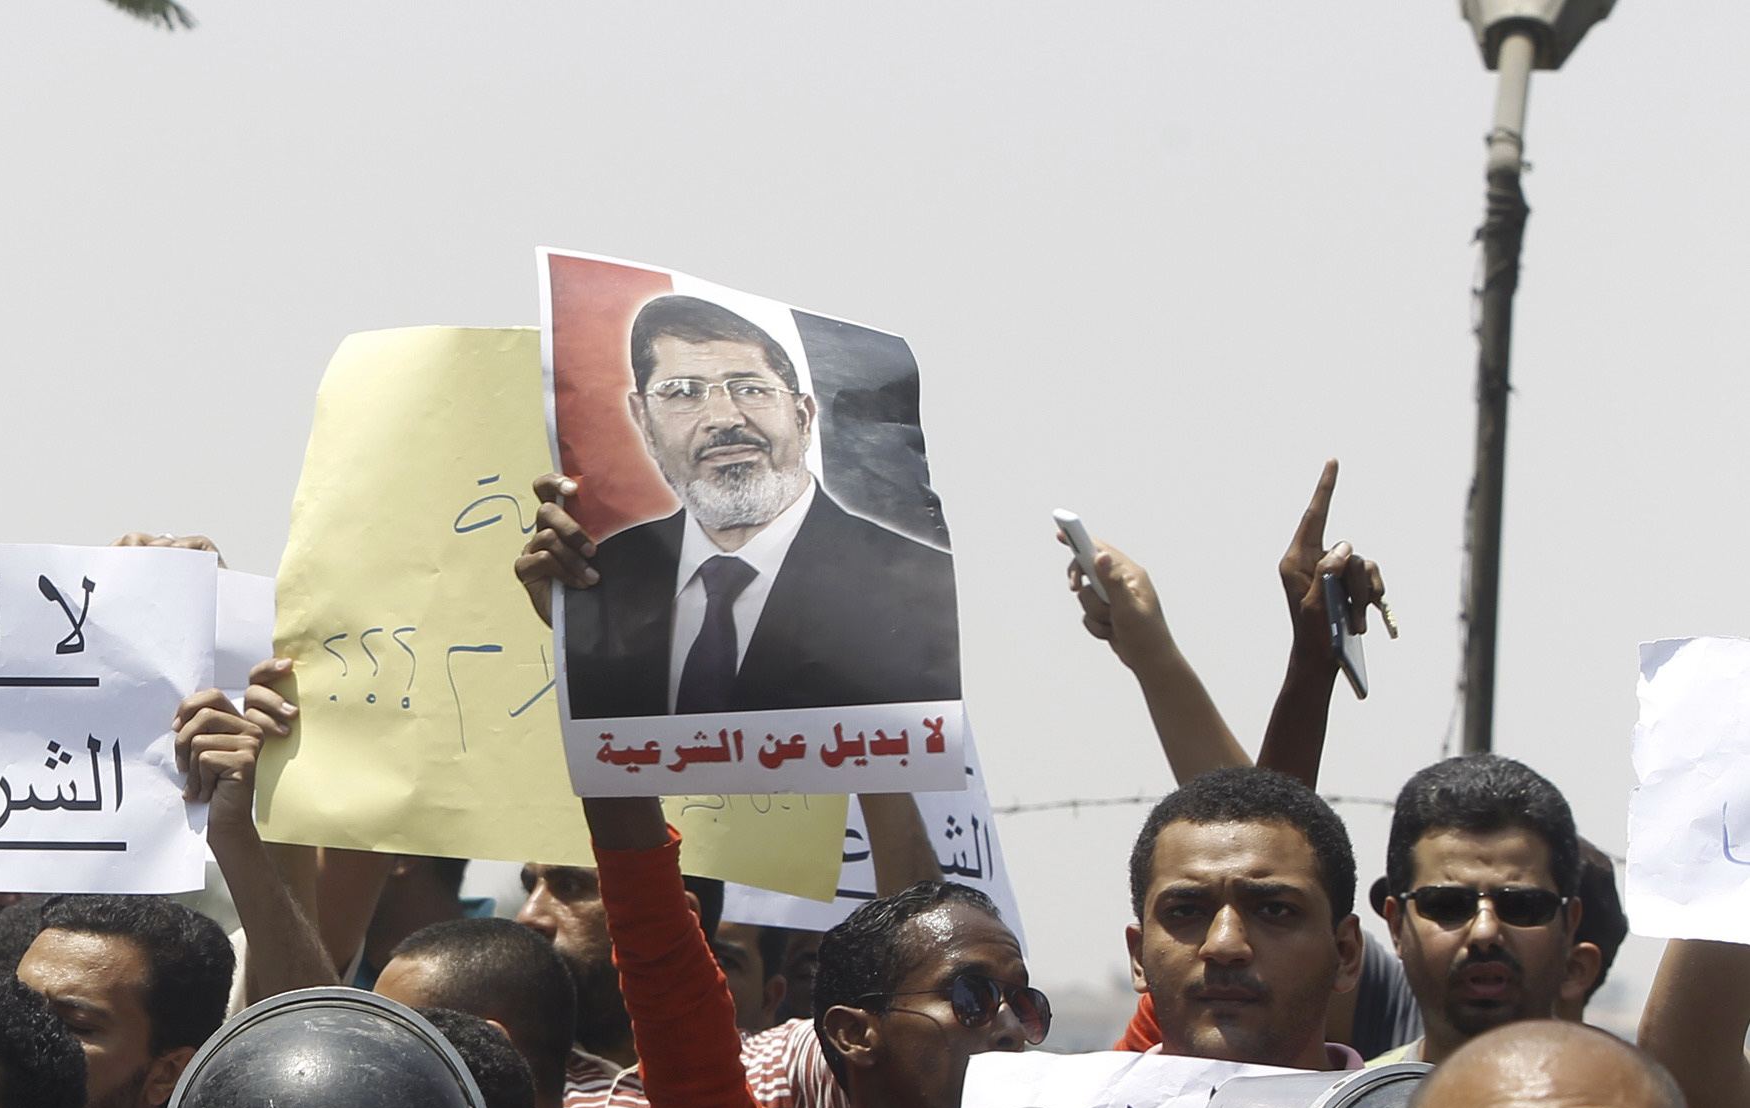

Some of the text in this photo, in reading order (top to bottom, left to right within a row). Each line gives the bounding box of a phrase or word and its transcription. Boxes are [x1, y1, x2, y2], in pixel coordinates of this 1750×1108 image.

[38, 570, 97, 656] لا
[595, 715, 946, 774] لا بديل عن الشرعية
